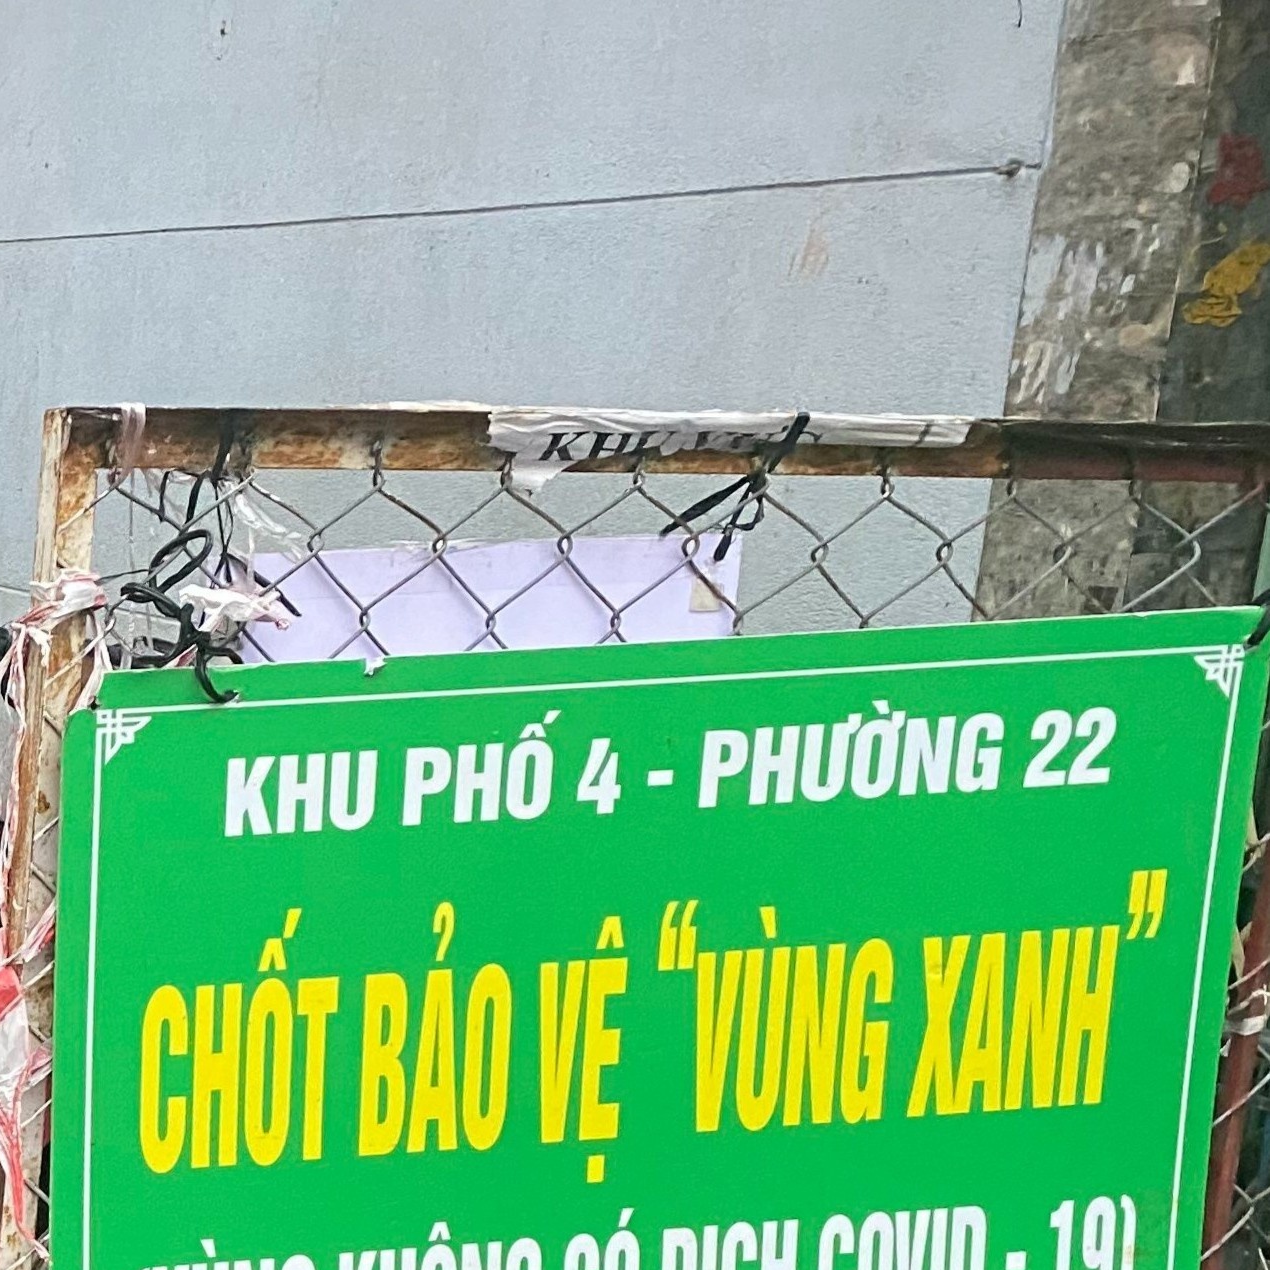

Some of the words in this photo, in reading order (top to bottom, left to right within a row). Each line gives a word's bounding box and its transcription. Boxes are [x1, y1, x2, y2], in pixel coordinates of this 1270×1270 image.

[224, 750, 378, 837] KHU
[402, 709, 561, 827] PHỐ
[576, 737, 621, 815] 4
[647, 769, 674, 786] -
[697, 700, 1005, 808] PHƯỜNG
[1022, 706, 1117, 788] 22
[140, 908, 339, 1173] CHỐT
[358, 901, 512, 1156] BẢO
[540, 916, 628, 1184] VỆ
[658, 899, 894, 1132] “VÙNG
[907, 868, 1168, 1118] XANH”
